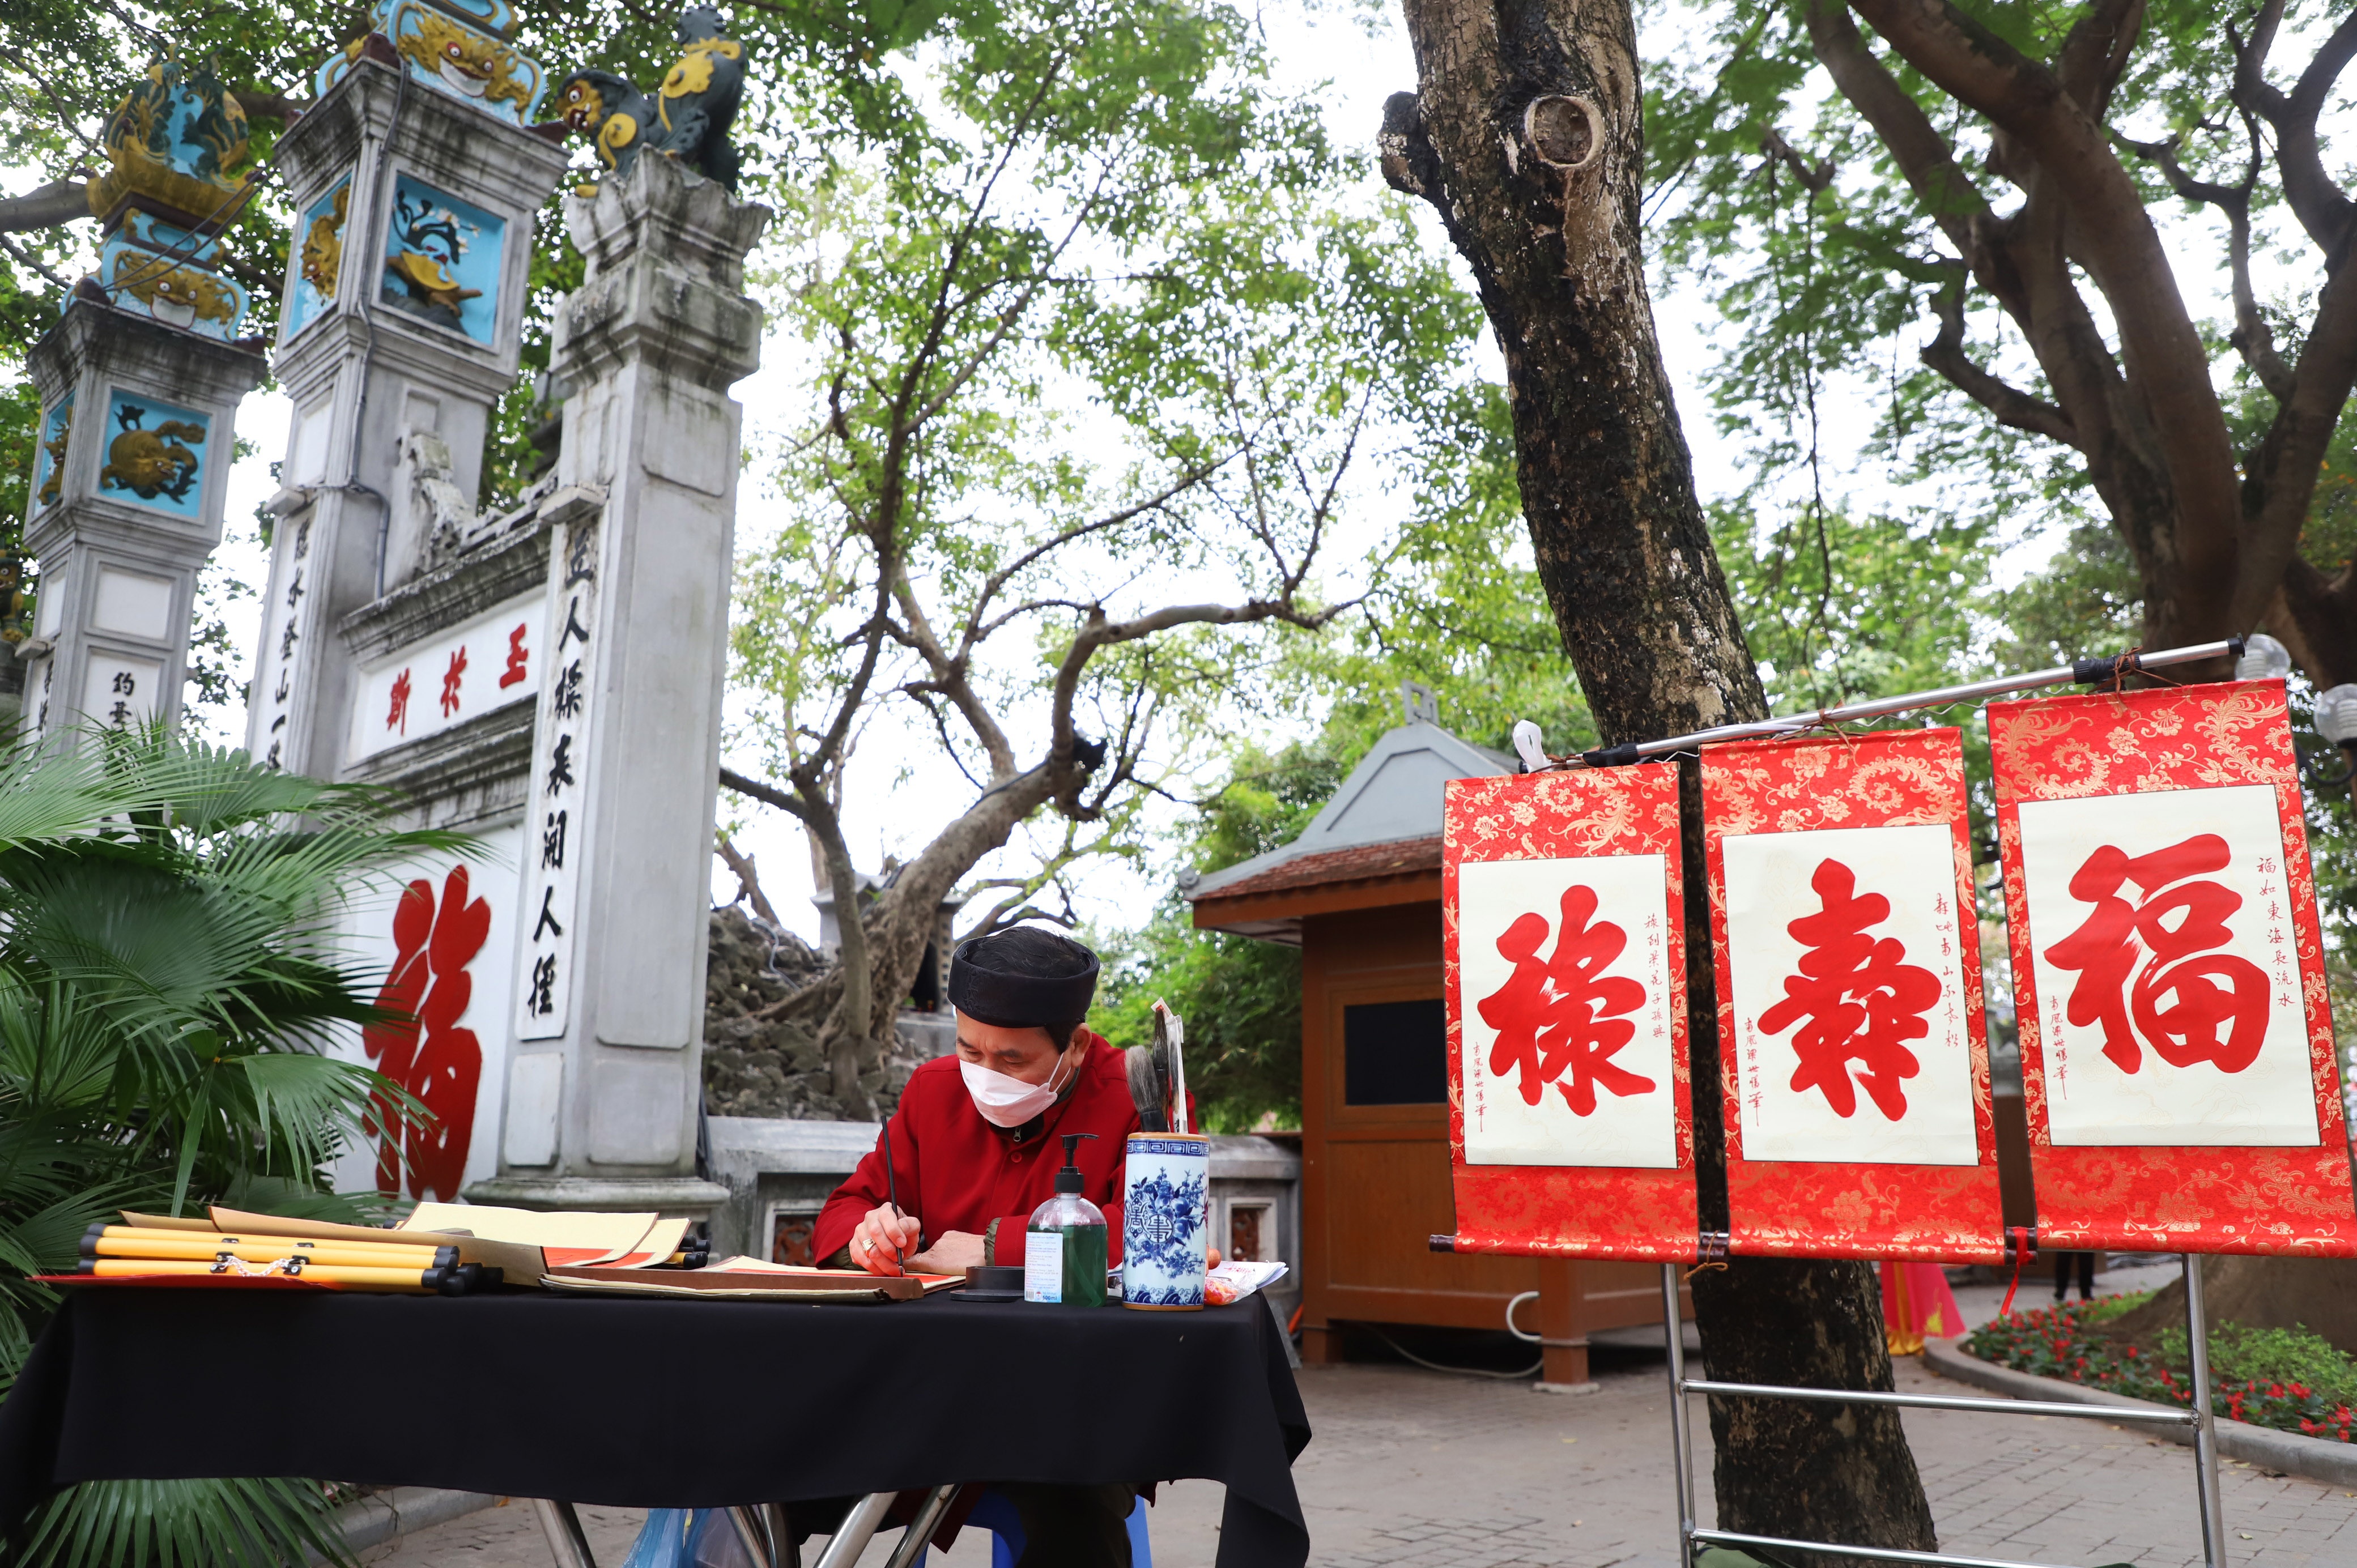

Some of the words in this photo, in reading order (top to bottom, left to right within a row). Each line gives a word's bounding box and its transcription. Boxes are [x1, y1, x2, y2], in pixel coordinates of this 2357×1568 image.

[362, 864, 491, 1208] 福
[2044, 833, 2271, 1075] 福
[2257, 857, 2295, 1007] 福如東海長流水
